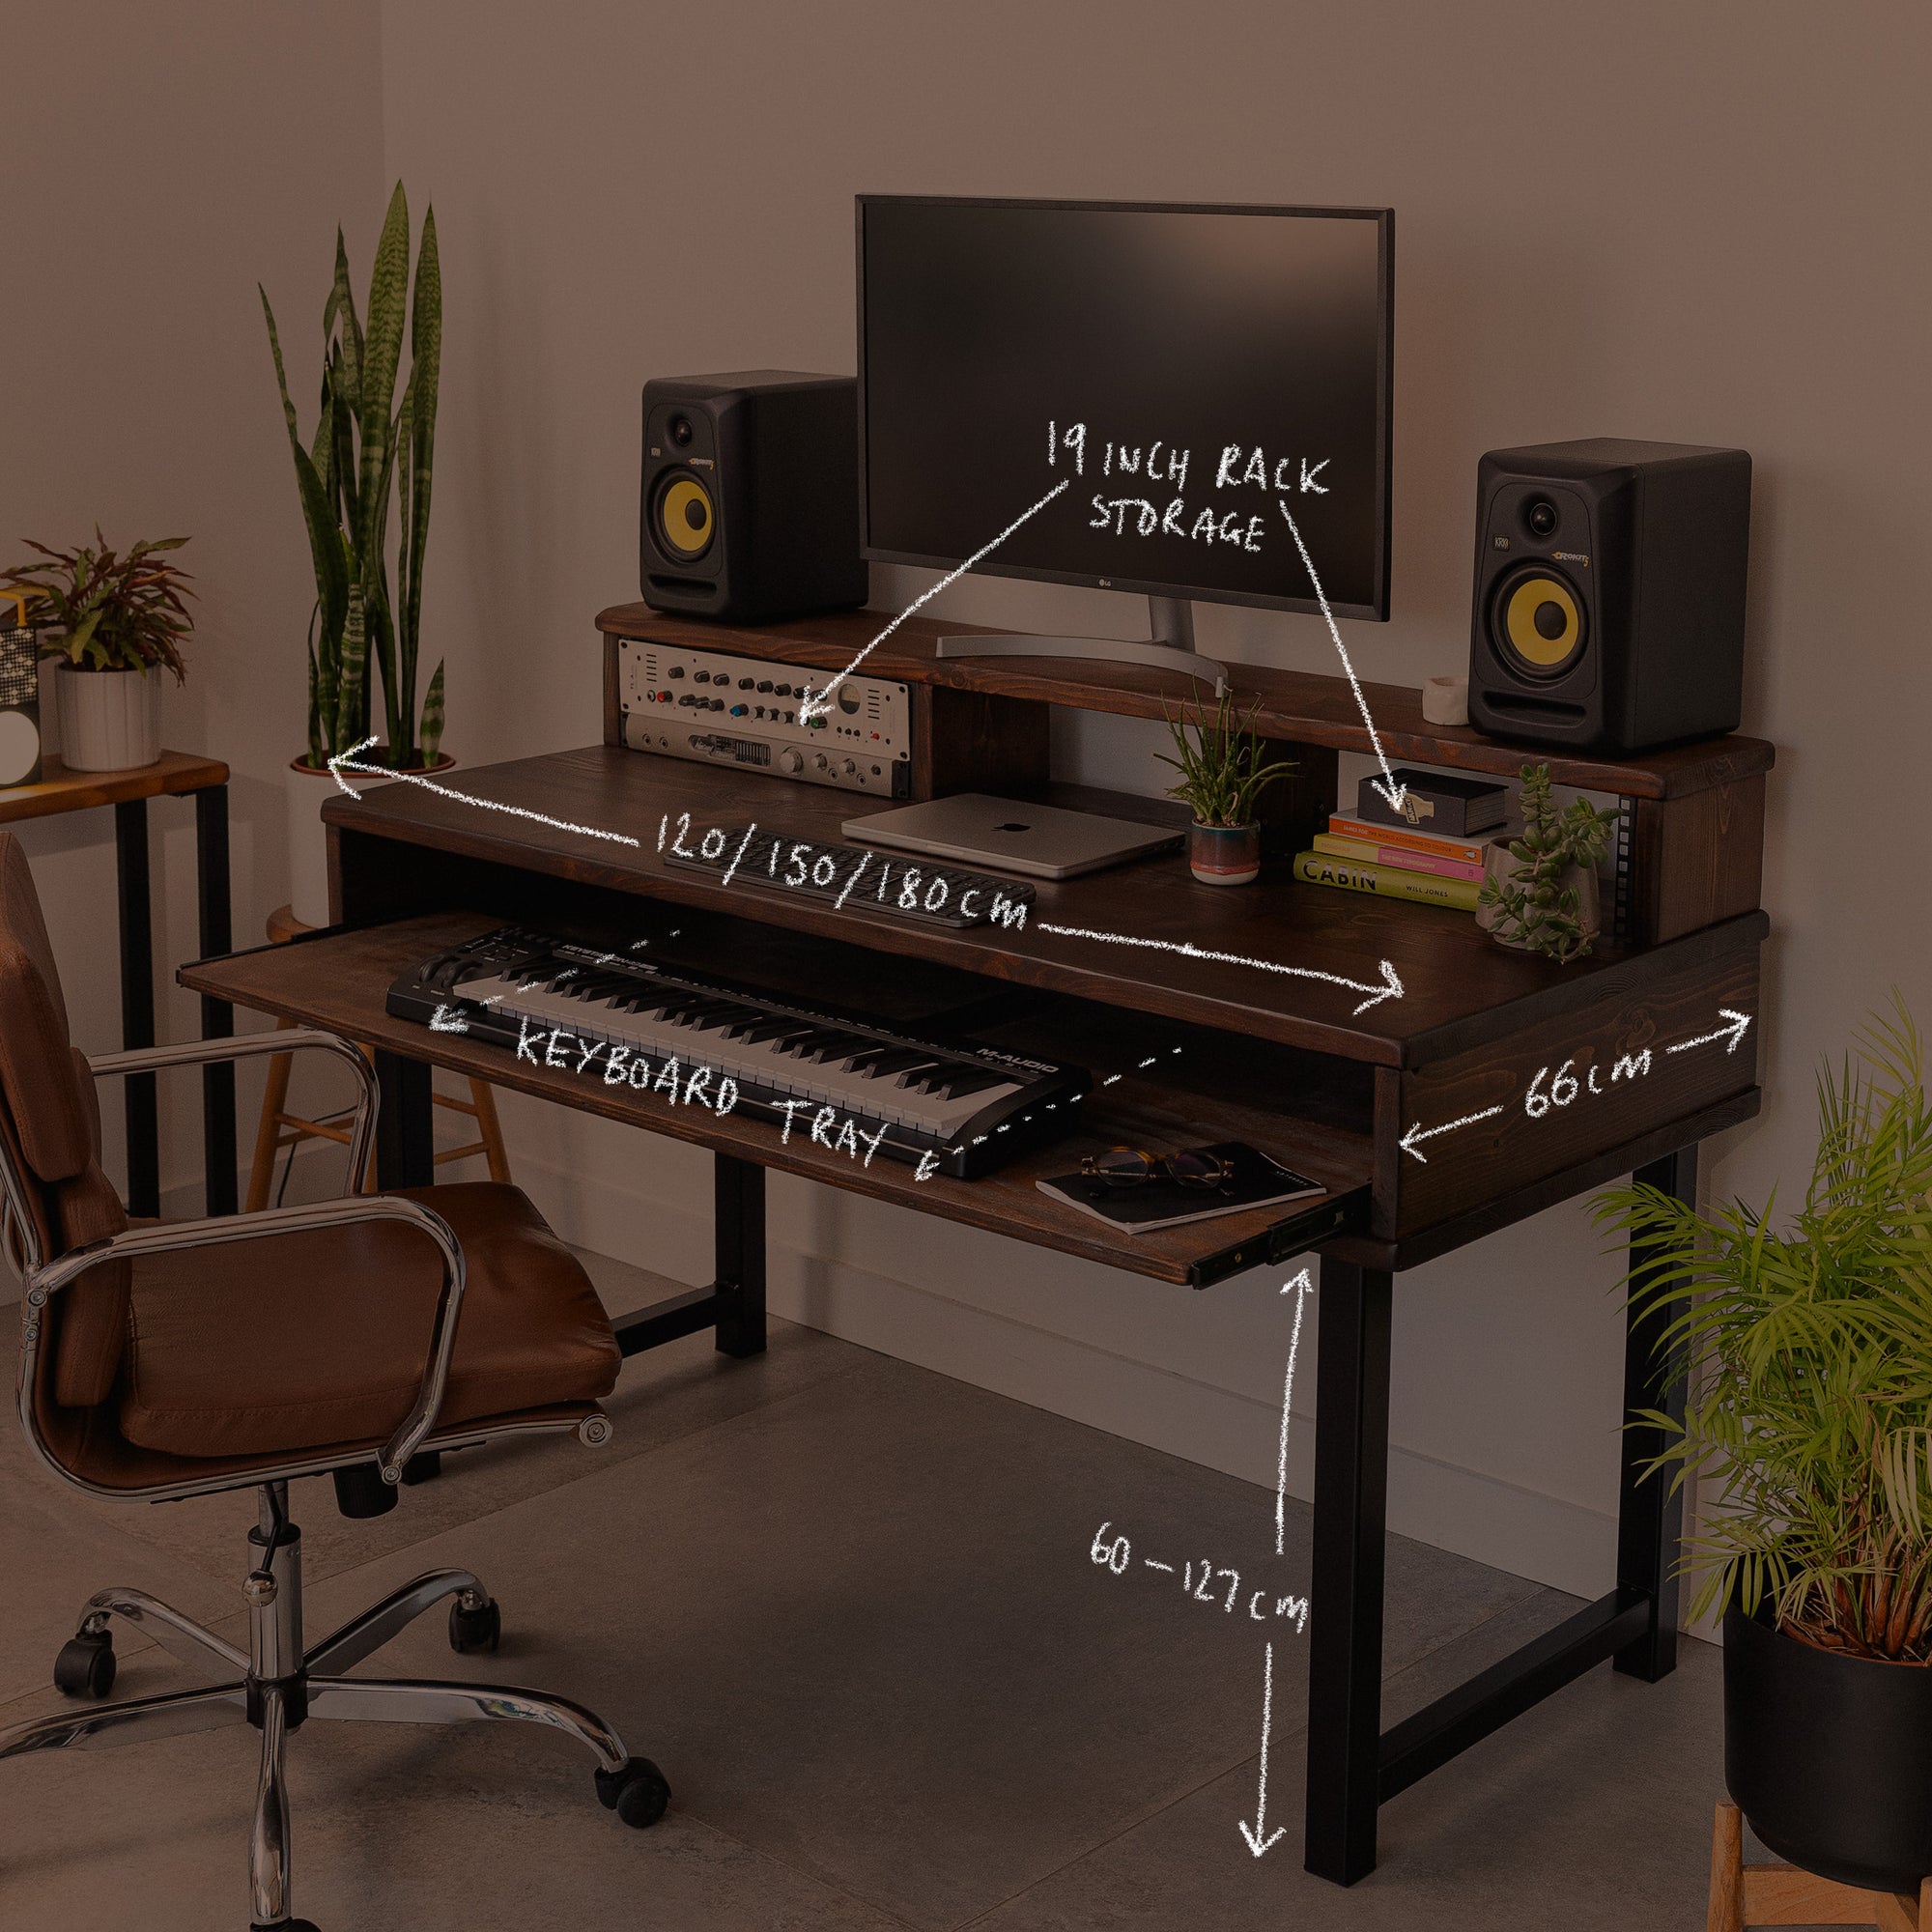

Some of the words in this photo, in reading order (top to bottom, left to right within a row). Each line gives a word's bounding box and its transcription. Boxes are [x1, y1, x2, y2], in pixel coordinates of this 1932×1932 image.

[1303, 860, 1378, 891] CABIN
[1406, 885, 1423, 894] WILL
[1425, 888, 1449, 897] JONES
[976, 1048, 1060, 1073] M-AUDIO
